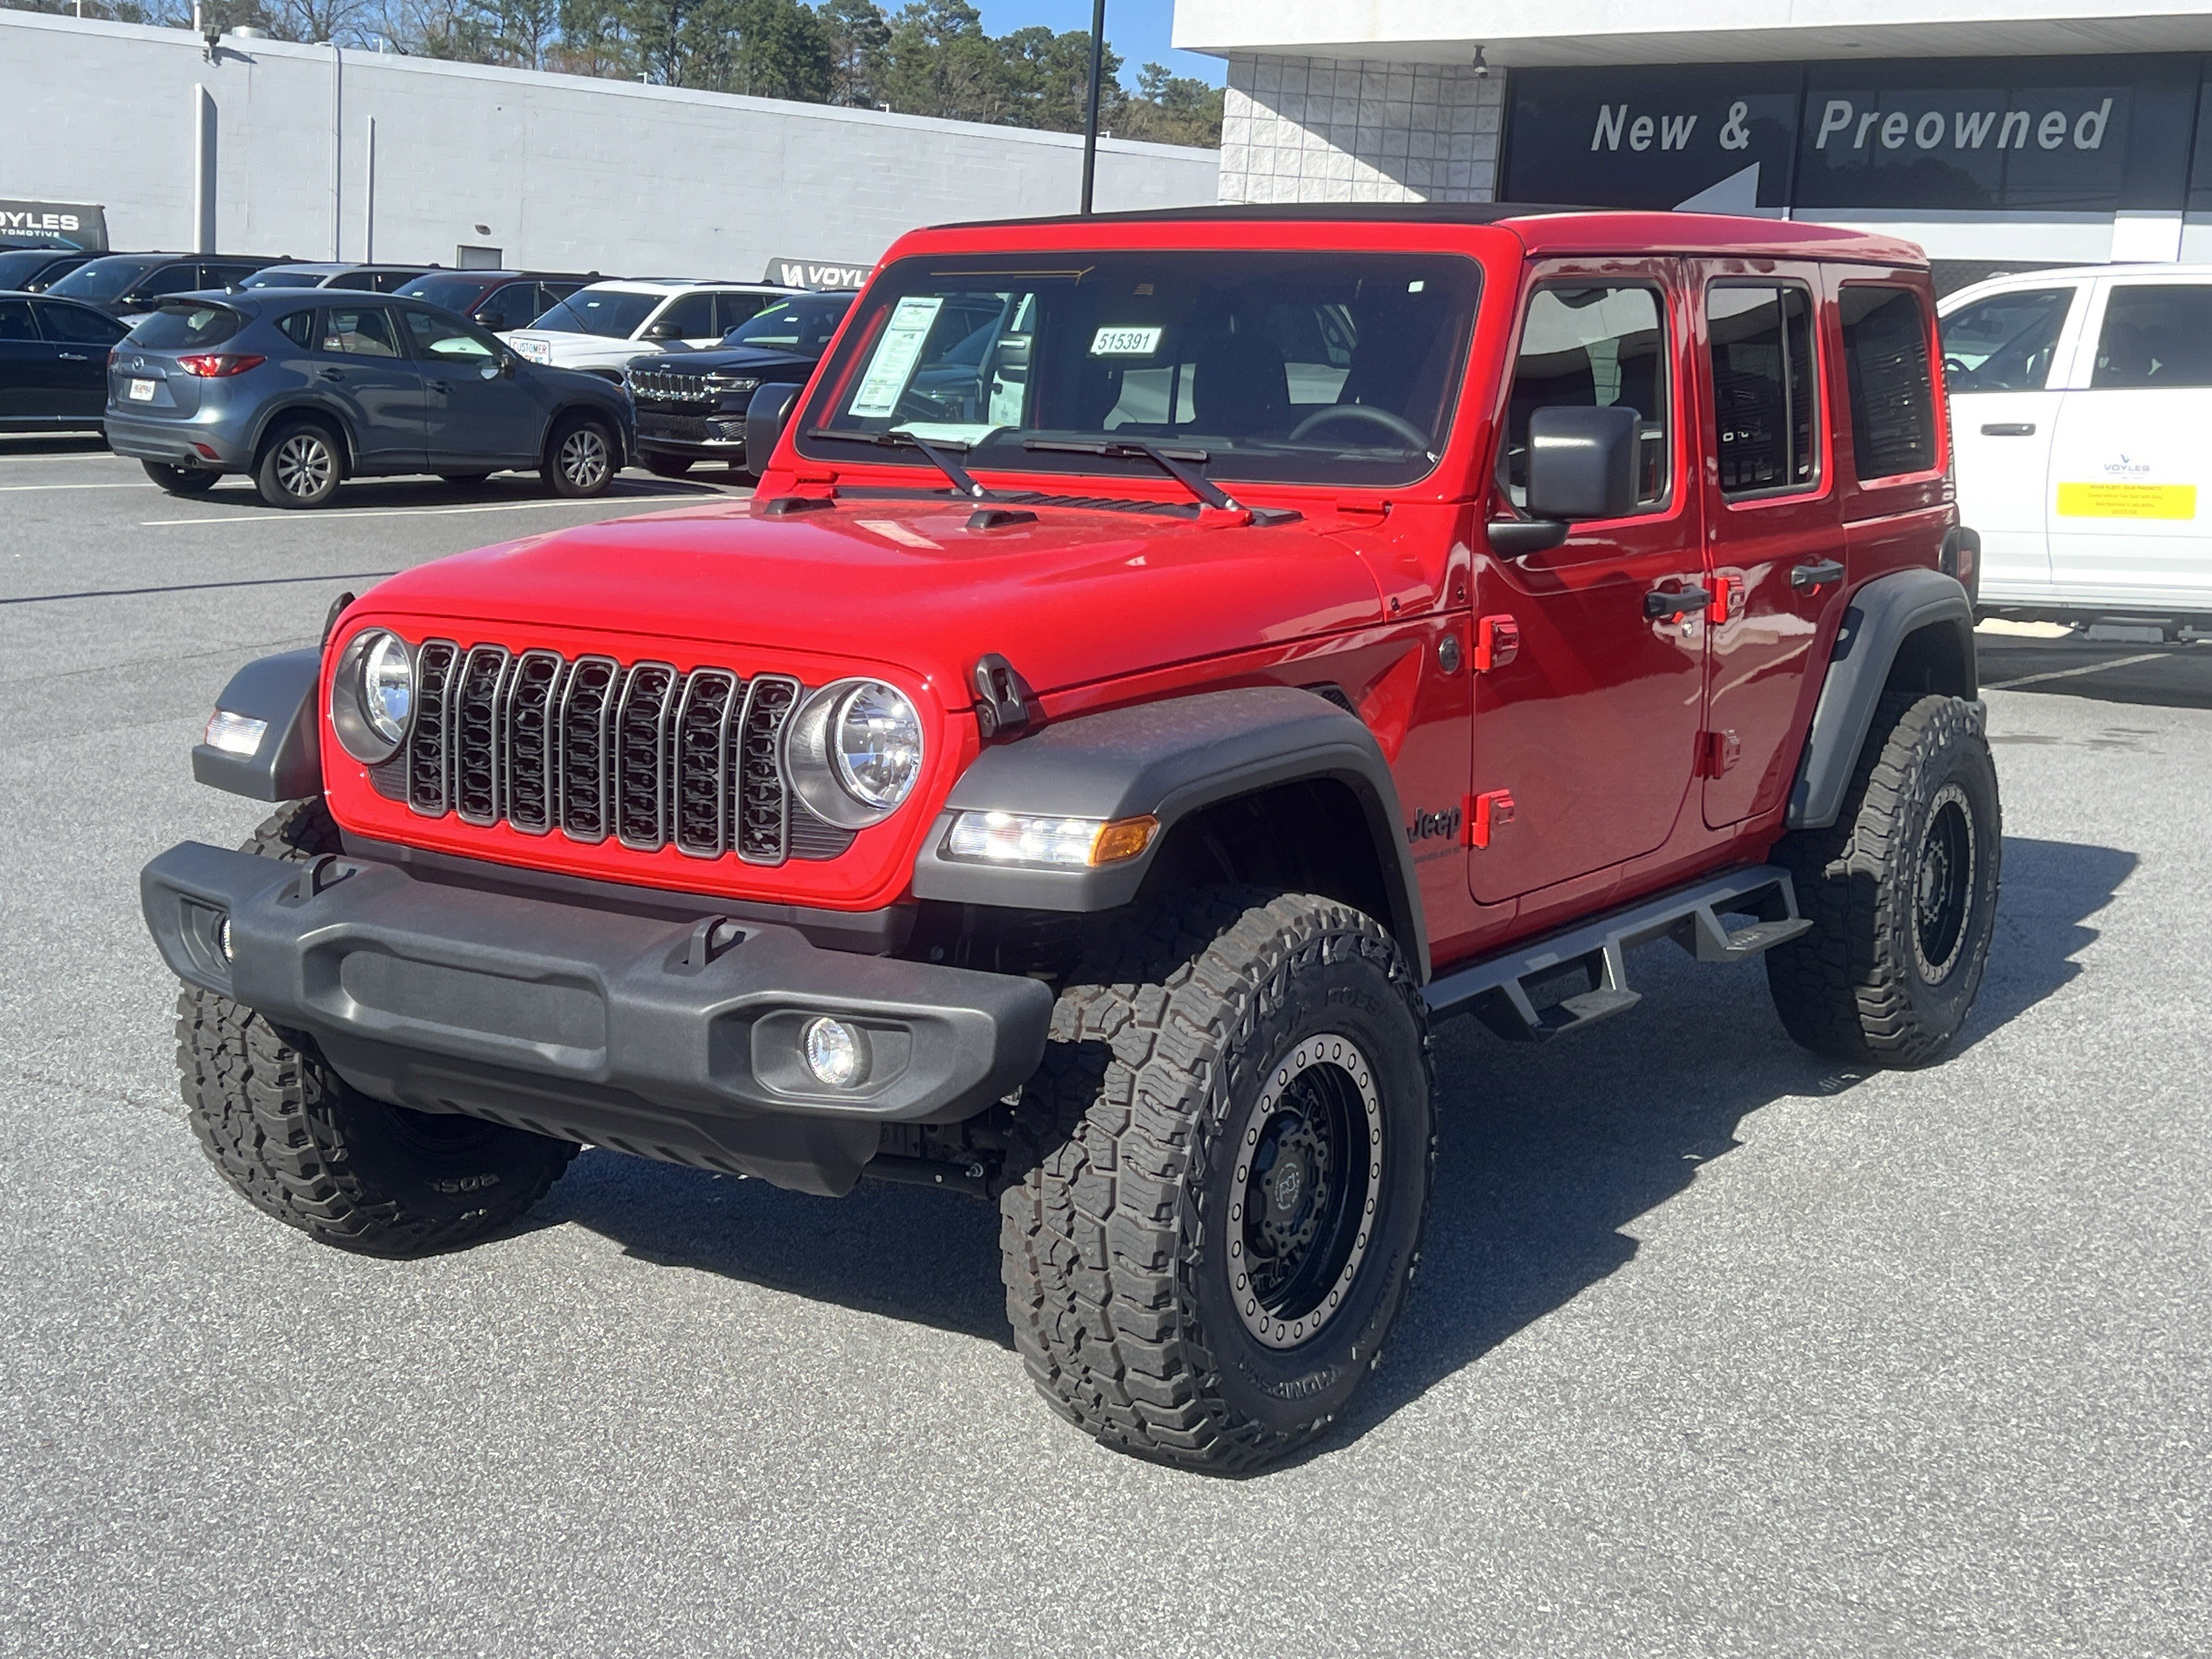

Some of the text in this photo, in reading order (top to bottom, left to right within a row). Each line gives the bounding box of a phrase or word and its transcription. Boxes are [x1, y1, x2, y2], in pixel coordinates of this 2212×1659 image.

[1591, 98, 2113, 151] New & Preowned
[808, 266, 873, 287] VOYL
[513, 341, 547, 356] CUSTOMER
[1098, 333, 1150, 350] 515391
[1407, 806, 1462, 843] Jeep
